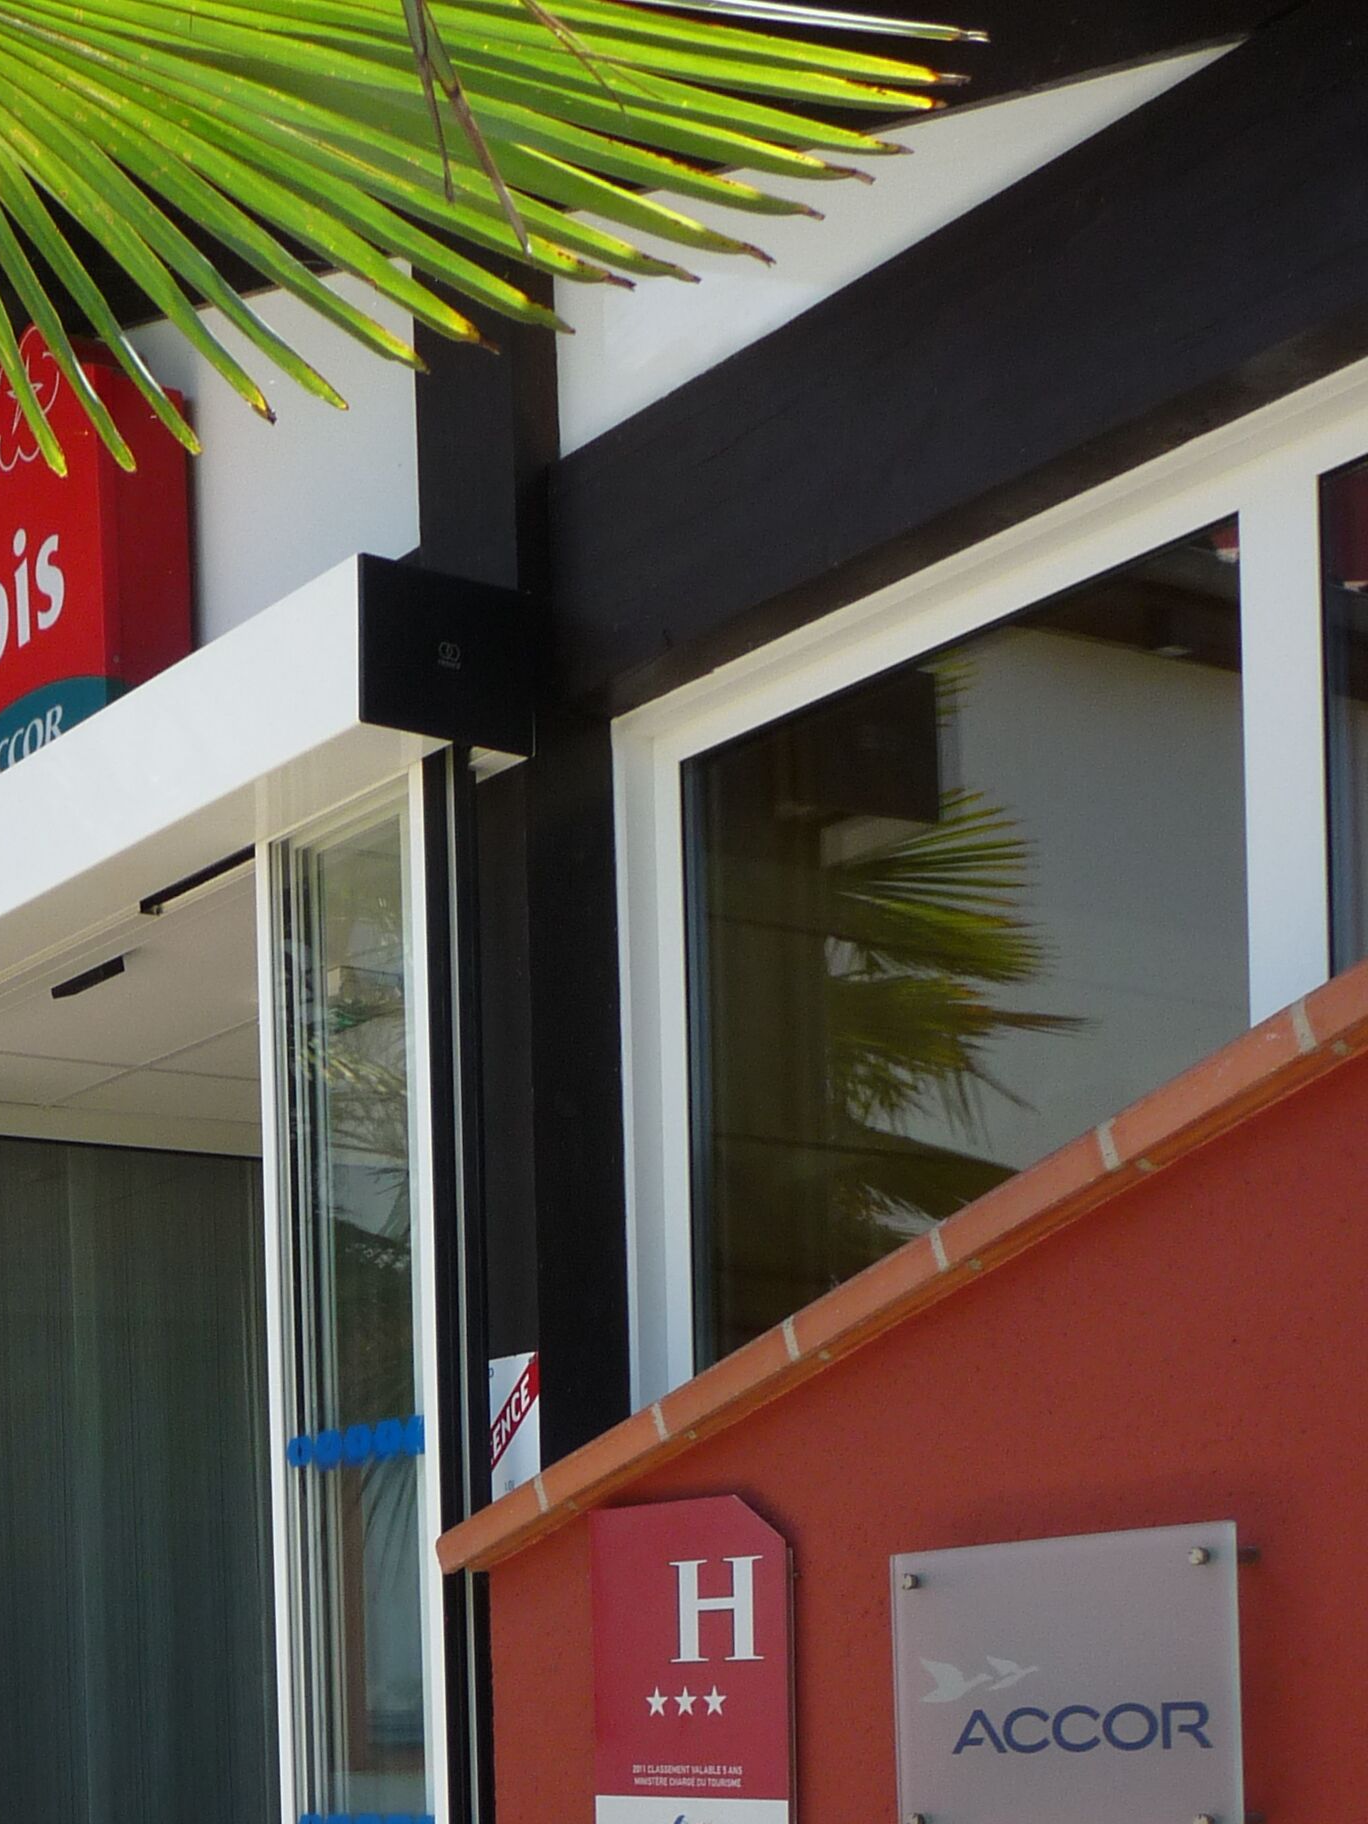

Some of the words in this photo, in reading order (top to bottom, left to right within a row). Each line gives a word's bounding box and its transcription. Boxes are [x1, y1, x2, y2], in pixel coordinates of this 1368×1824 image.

[490, 1374, 531, 1466] ENCE
[669, 1555, 765, 1664] H
[952, 1701, 1214, 1755] ACCOR
[647, 1764, 690, 1775] CLASSEMENT
[691, 1765, 721, 1775] VALABLE
[708, 1778, 742, 1788] TOURISME
